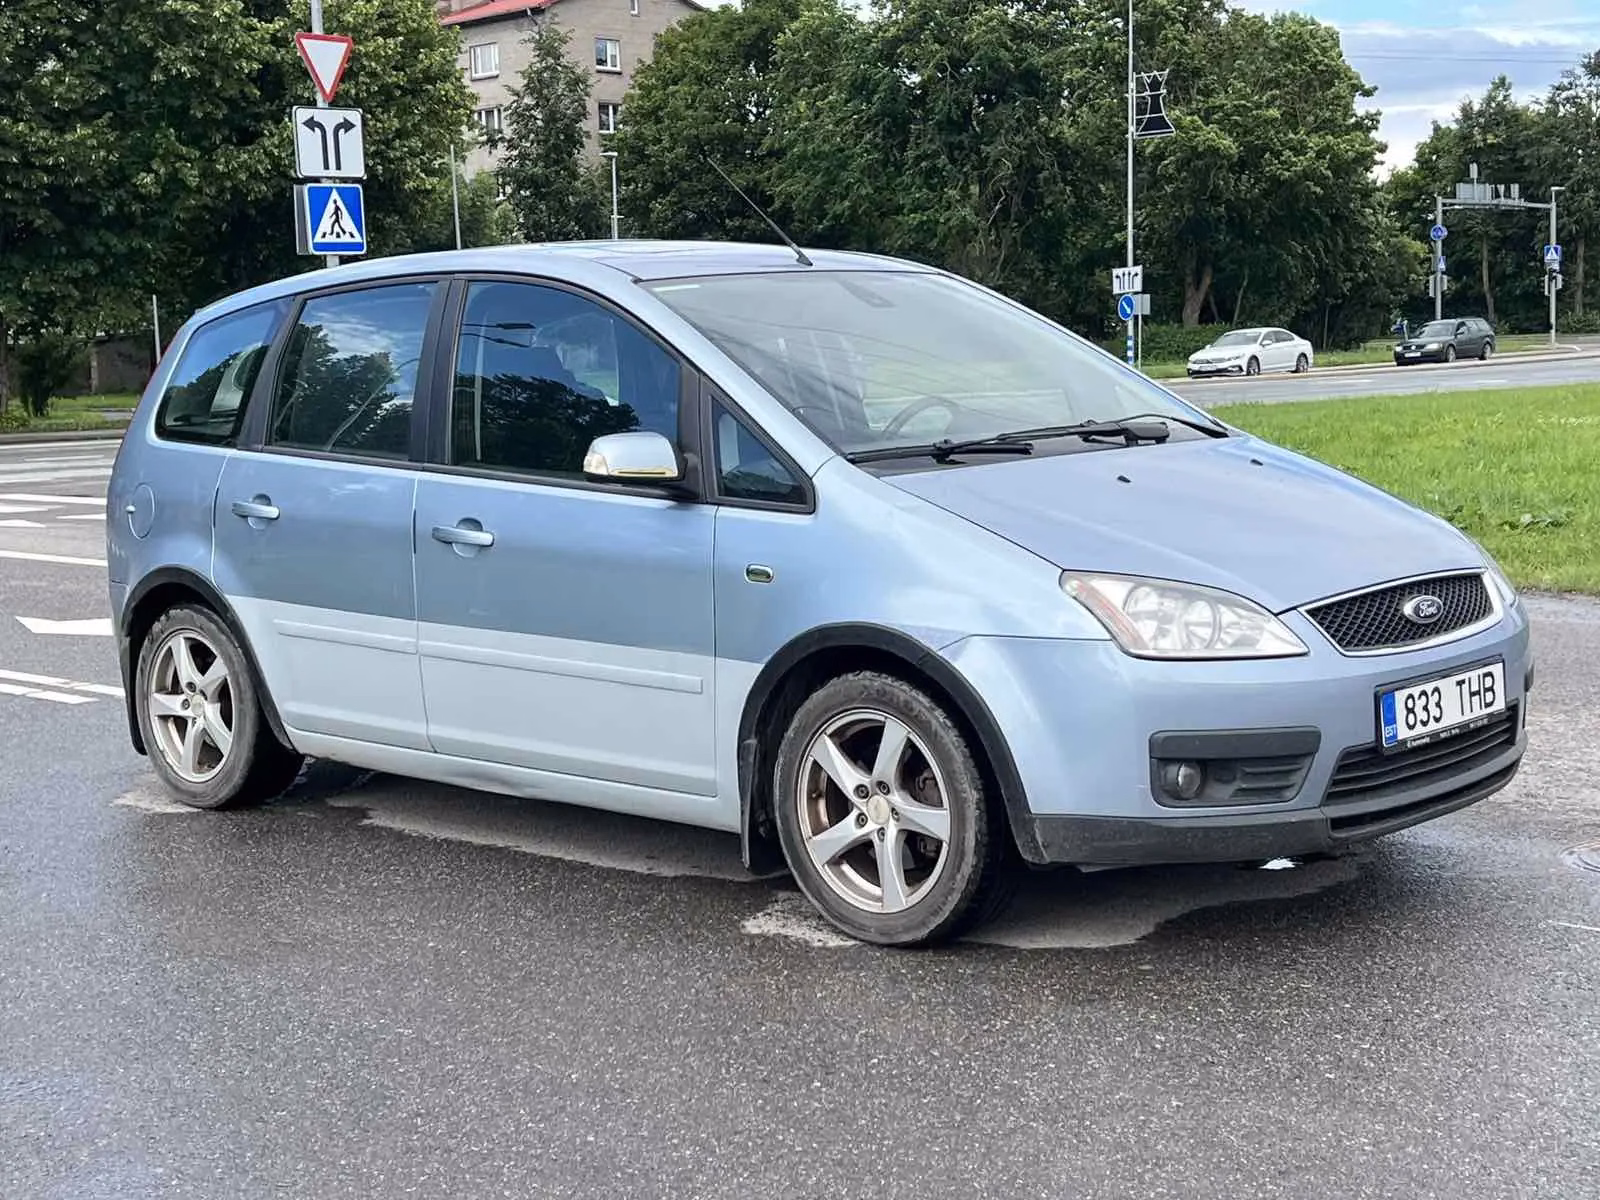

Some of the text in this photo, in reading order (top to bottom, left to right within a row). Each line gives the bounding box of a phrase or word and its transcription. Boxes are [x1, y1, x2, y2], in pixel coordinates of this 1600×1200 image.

[1405, 671, 1496, 730] 833 THB
[1384, 724, 1397, 738] EST
